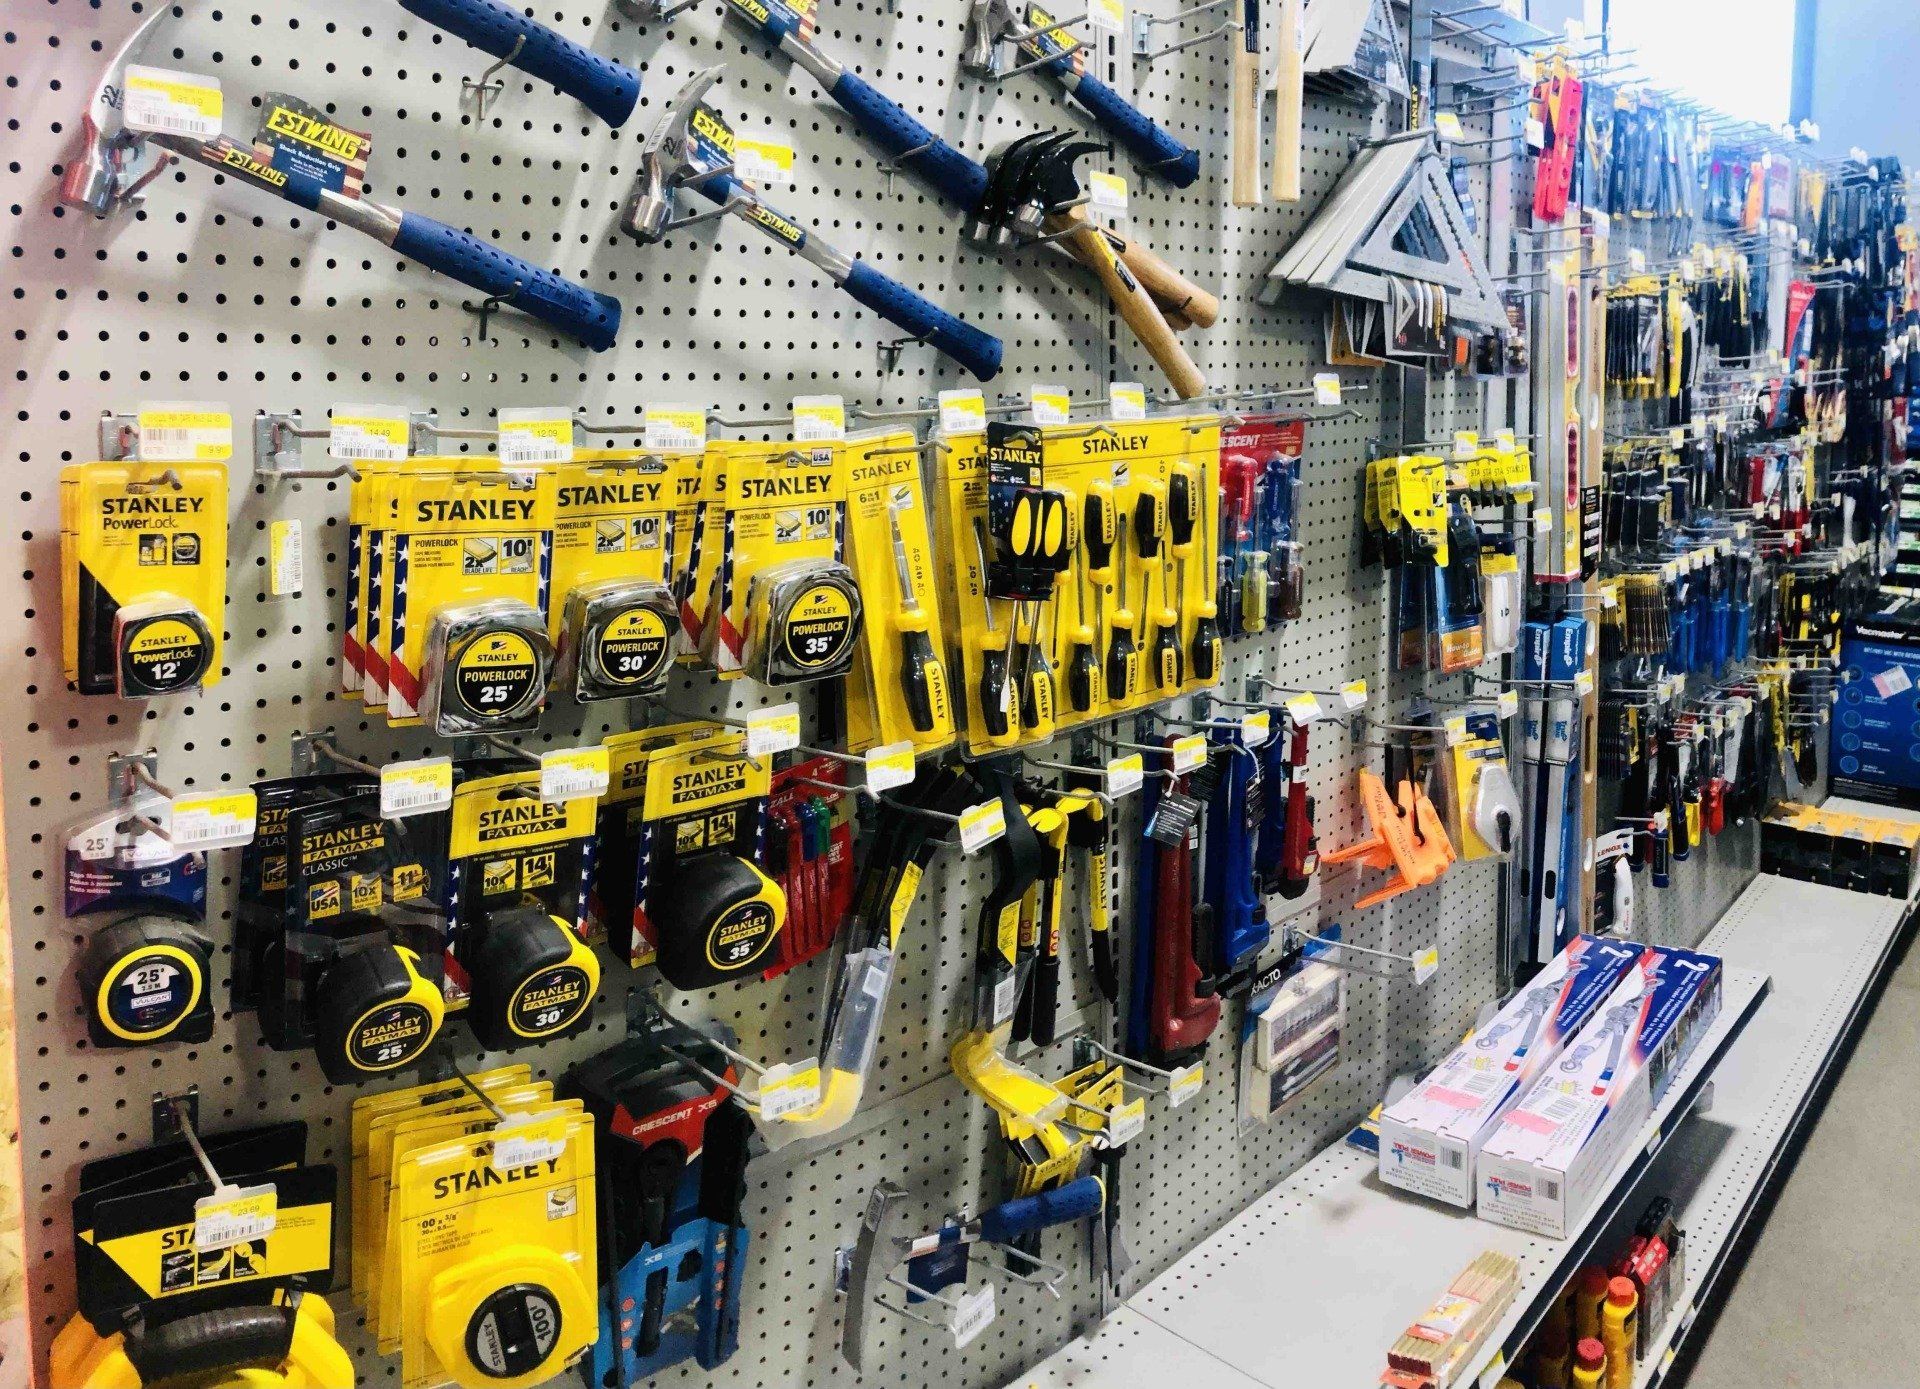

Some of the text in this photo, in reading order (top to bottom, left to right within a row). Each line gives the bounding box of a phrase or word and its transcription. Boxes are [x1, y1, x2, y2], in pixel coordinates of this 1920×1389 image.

[101, 85, 119, 108] 22
[267, 106, 362, 160] ESTWING
[223, 148, 289, 187] ESTWING
[299, 150, 327, 167] Reduction
[328, 162, 341, 172] Grip
[758, 208, 801, 242] ESTWING
[1082, 436, 1148, 455] STANLEY
[813, 453, 830, 462] USA
[990, 447, 1040, 464] STANLEY
[852, 459, 912, 481] STANLEY
[1506, 465, 1529, 475] STANLEY
[557, 482, 661, 507] STANLEY
[741, 474, 832, 498] STANLEY
[102, 498, 204, 514] STANLEY
[859, 493, 867, 503] 6
[417, 499, 536, 522] STANLEY
[103, 515, 179, 530] PowerLock
[556, 521, 592, 531] POWERLOCK
[415, 538, 459, 548] POWERLOCK
[803, 606, 837, 616] STANLEY
[617, 627, 653, 636] STANLEY
[792, 621, 844, 636] POWERLOCK
[141, 635, 187, 647] STANLEY
[606, 642, 659, 654] POWERLOCK
[805, 636, 833, 654] 35'
[133, 646, 195, 664] PowerLock
[477, 653, 519, 662] STANLEY
[618, 655, 647, 672] 30'
[151, 661, 180, 680] 12'
[464, 669, 528, 683] POWERLOCK
[480, 685, 513, 703] 25'
[931, 668, 945, 719] STANLEY
[1038, 677, 1049, 719] STANLEY
[673, 762, 747, 791] STANLEY
[679, 781, 739, 801] FATMAX
[478, 800, 567, 828] STANLEY
[302, 822, 385, 852] STANLEY
[486, 820, 557, 839] FATMAX
[86, 837, 109, 851] 25'
[1597, 843, 1622, 857] LENOX
[311, 899, 339, 912] USA
[720, 914, 767, 937] STANLEY
[721, 927, 763, 943] FATMAX
[729, 942, 754, 960] 35'
[137, 968, 165, 985] 25'
[524, 980, 580, 1002] STANLEY
[526, 992, 576, 1010] FATMAX
[535, 1008, 565, 1027] 30'
[362, 1016, 421, 1038] STANLEY
[365, 1027, 418, 1045] FATMAX
[377, 1043, 407, 1062] 25'
[632, 1107, 694, 1136] CRESCENT
[484, 1323, 502, 1367] STANLEY
